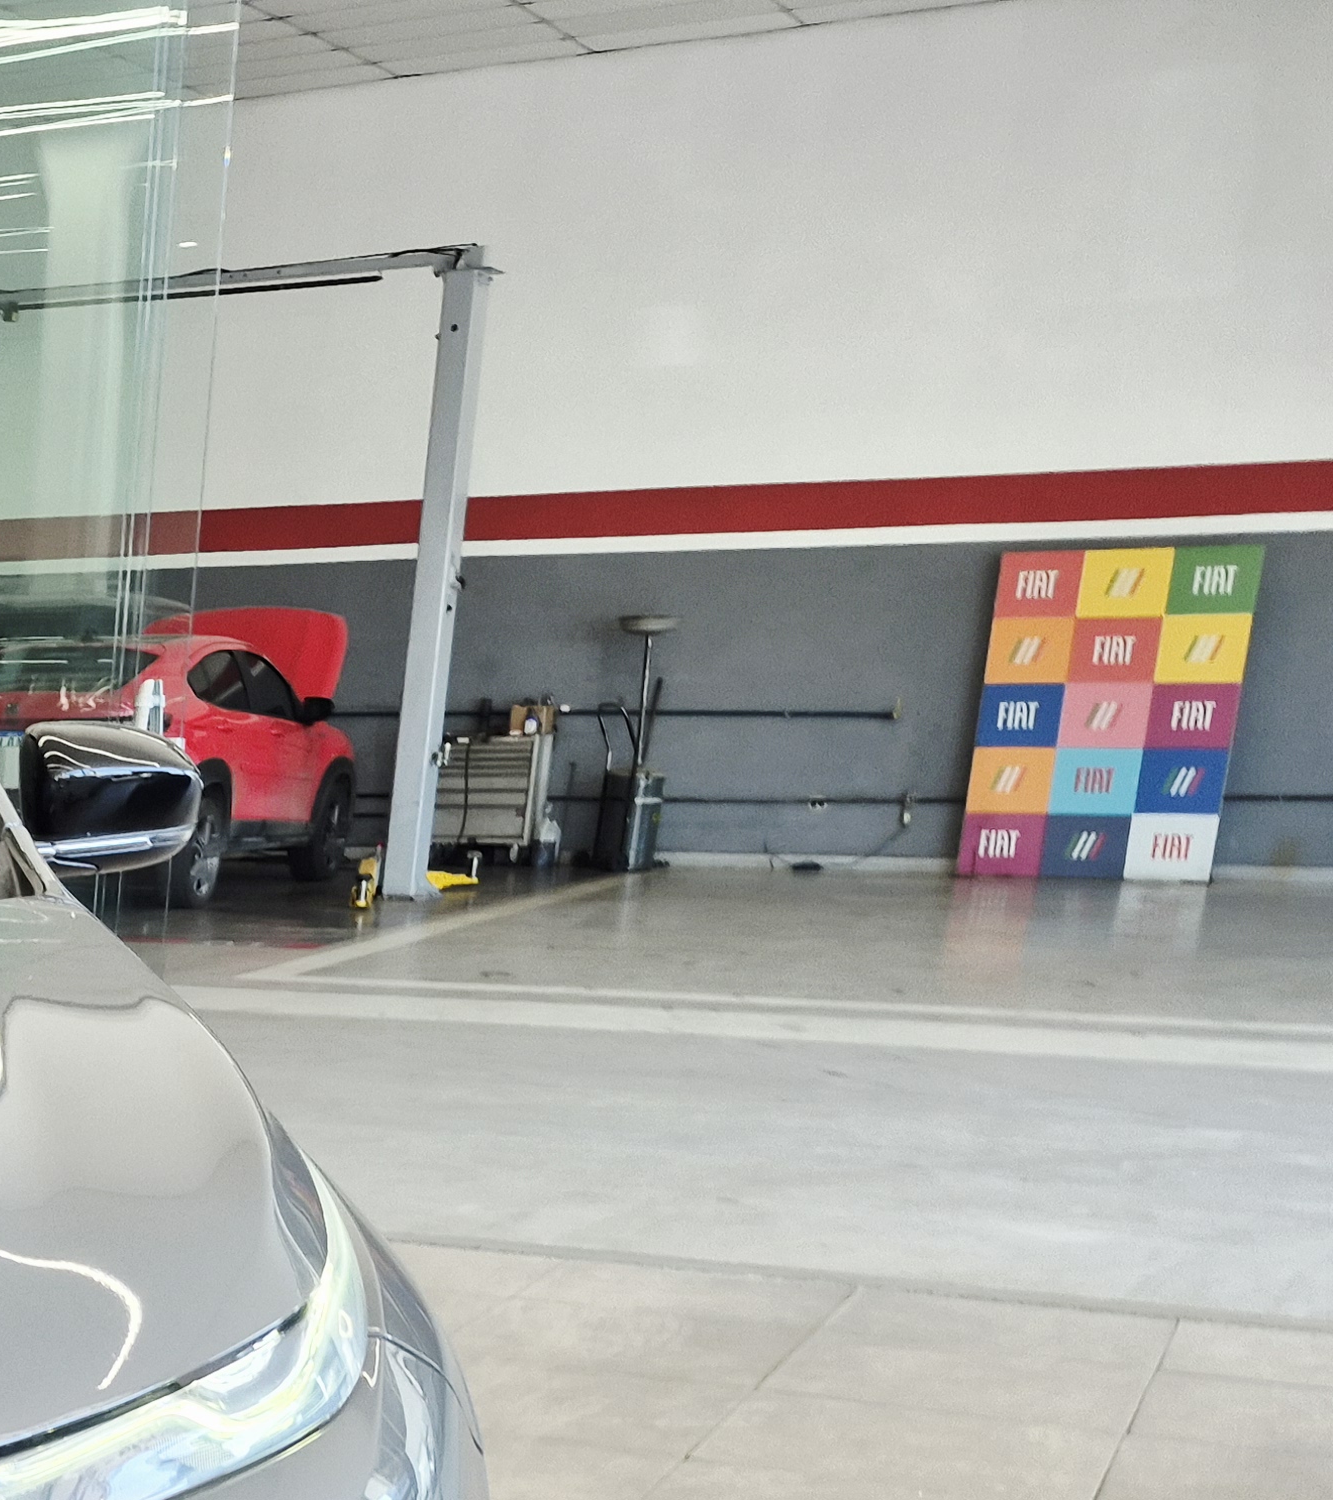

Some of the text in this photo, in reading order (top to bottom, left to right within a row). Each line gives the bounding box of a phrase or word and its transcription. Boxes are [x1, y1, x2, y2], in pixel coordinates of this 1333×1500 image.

[1015, 565, 1238, 600] FIAT FIAT
[1092, 635, 1136, 666] FIAT
[997, 700, 1217, 732] FIAT FIAT
[1074, 767, 1115, 794] FIAT
[978, 829, 1195, 861] FIAT FIAT
